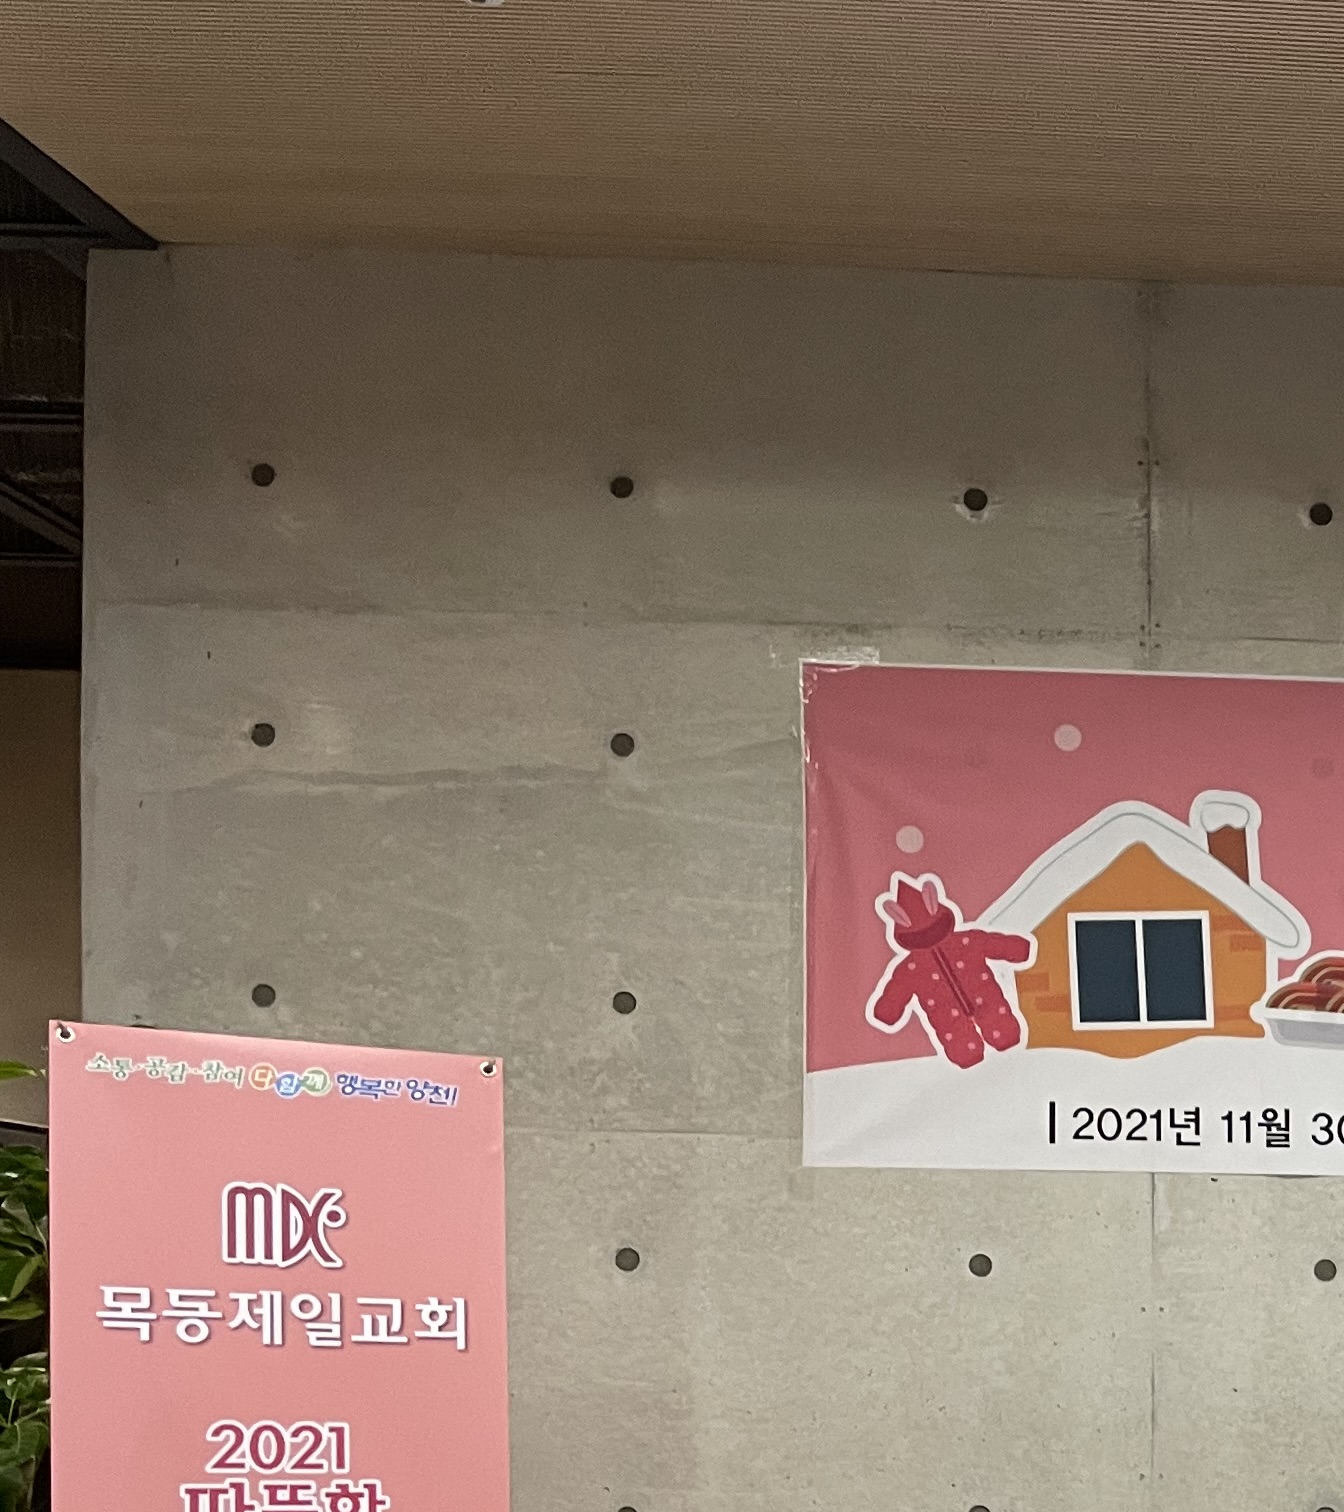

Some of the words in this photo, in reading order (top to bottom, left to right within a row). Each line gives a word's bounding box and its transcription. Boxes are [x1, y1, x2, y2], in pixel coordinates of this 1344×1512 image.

[1070, 1107, 1205, 1151] 2021년
[1220, 1109, 1295, 1151] 11월
[96, 1286, 469, 1351] 목동제일교회
[207, 1421, 352, 1472] 2021
